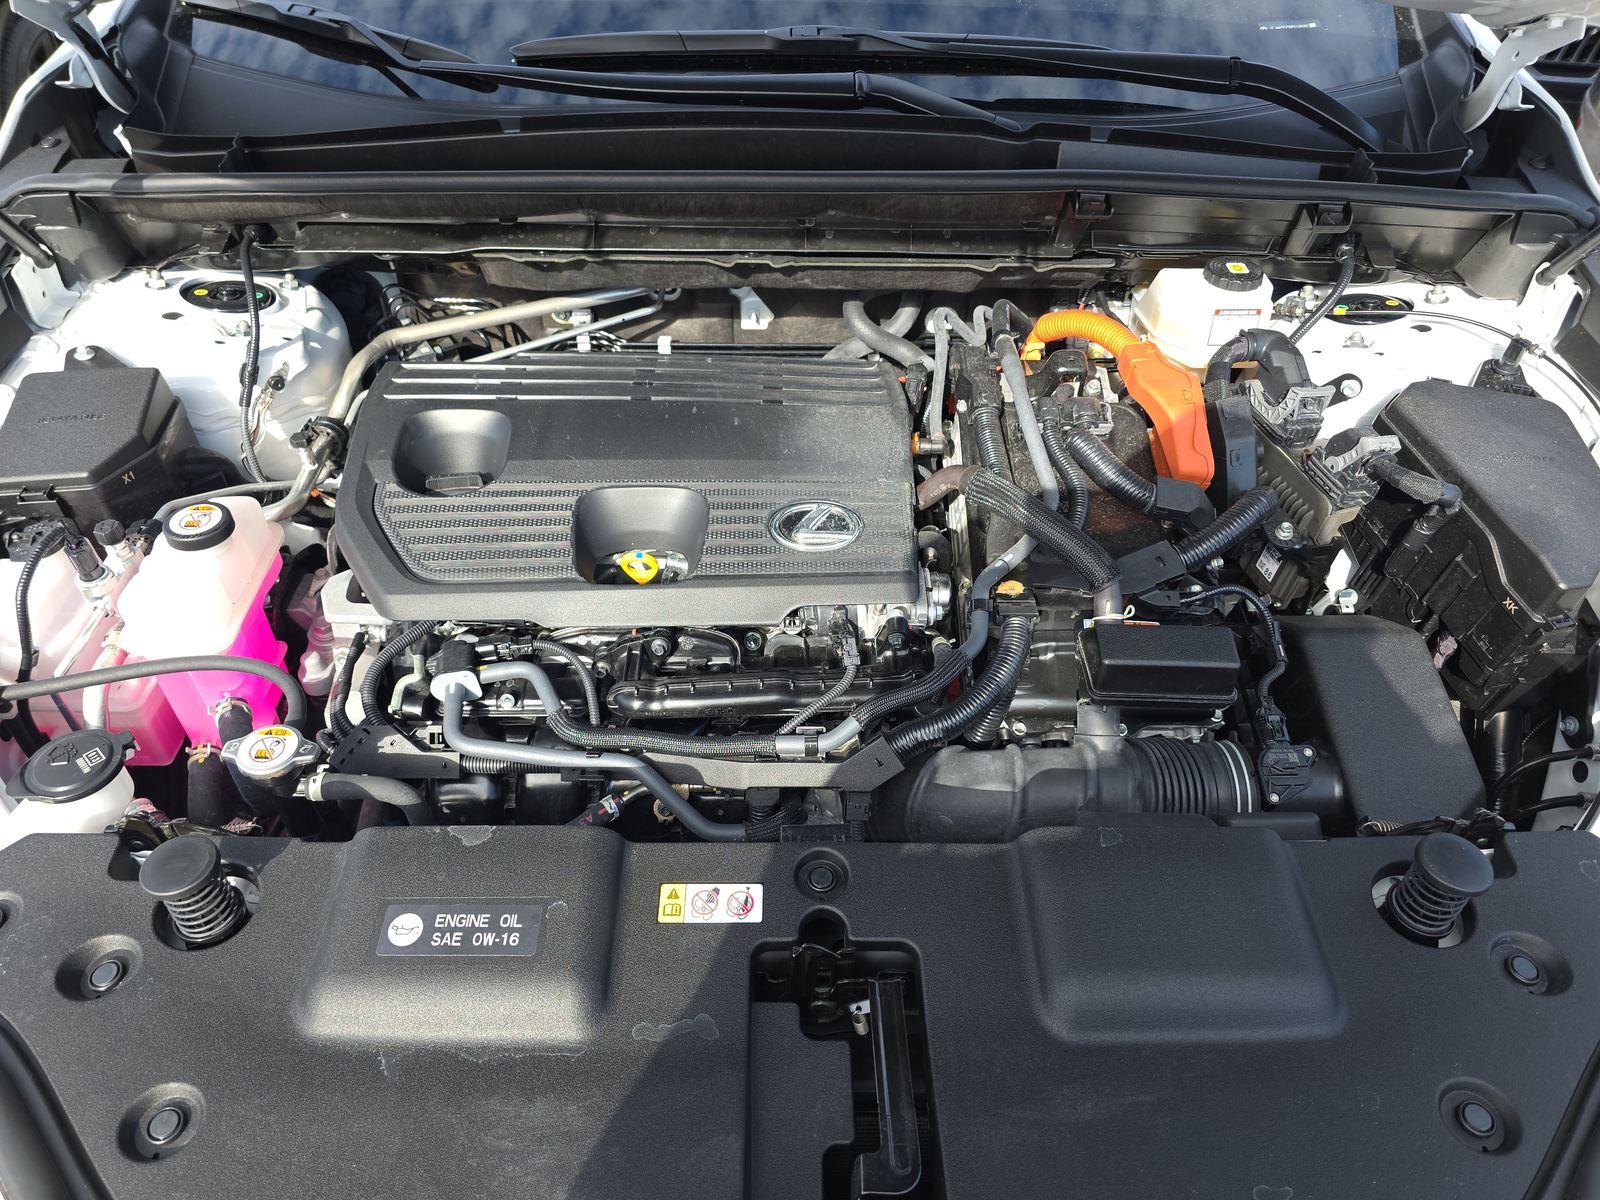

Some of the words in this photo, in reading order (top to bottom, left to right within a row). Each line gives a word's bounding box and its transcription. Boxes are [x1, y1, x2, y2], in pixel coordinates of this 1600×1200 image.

[434, 913, 491, 928] ENGINE
[499, 913, 523, 928] OIL
[430, 932, 464, 946] SAE
